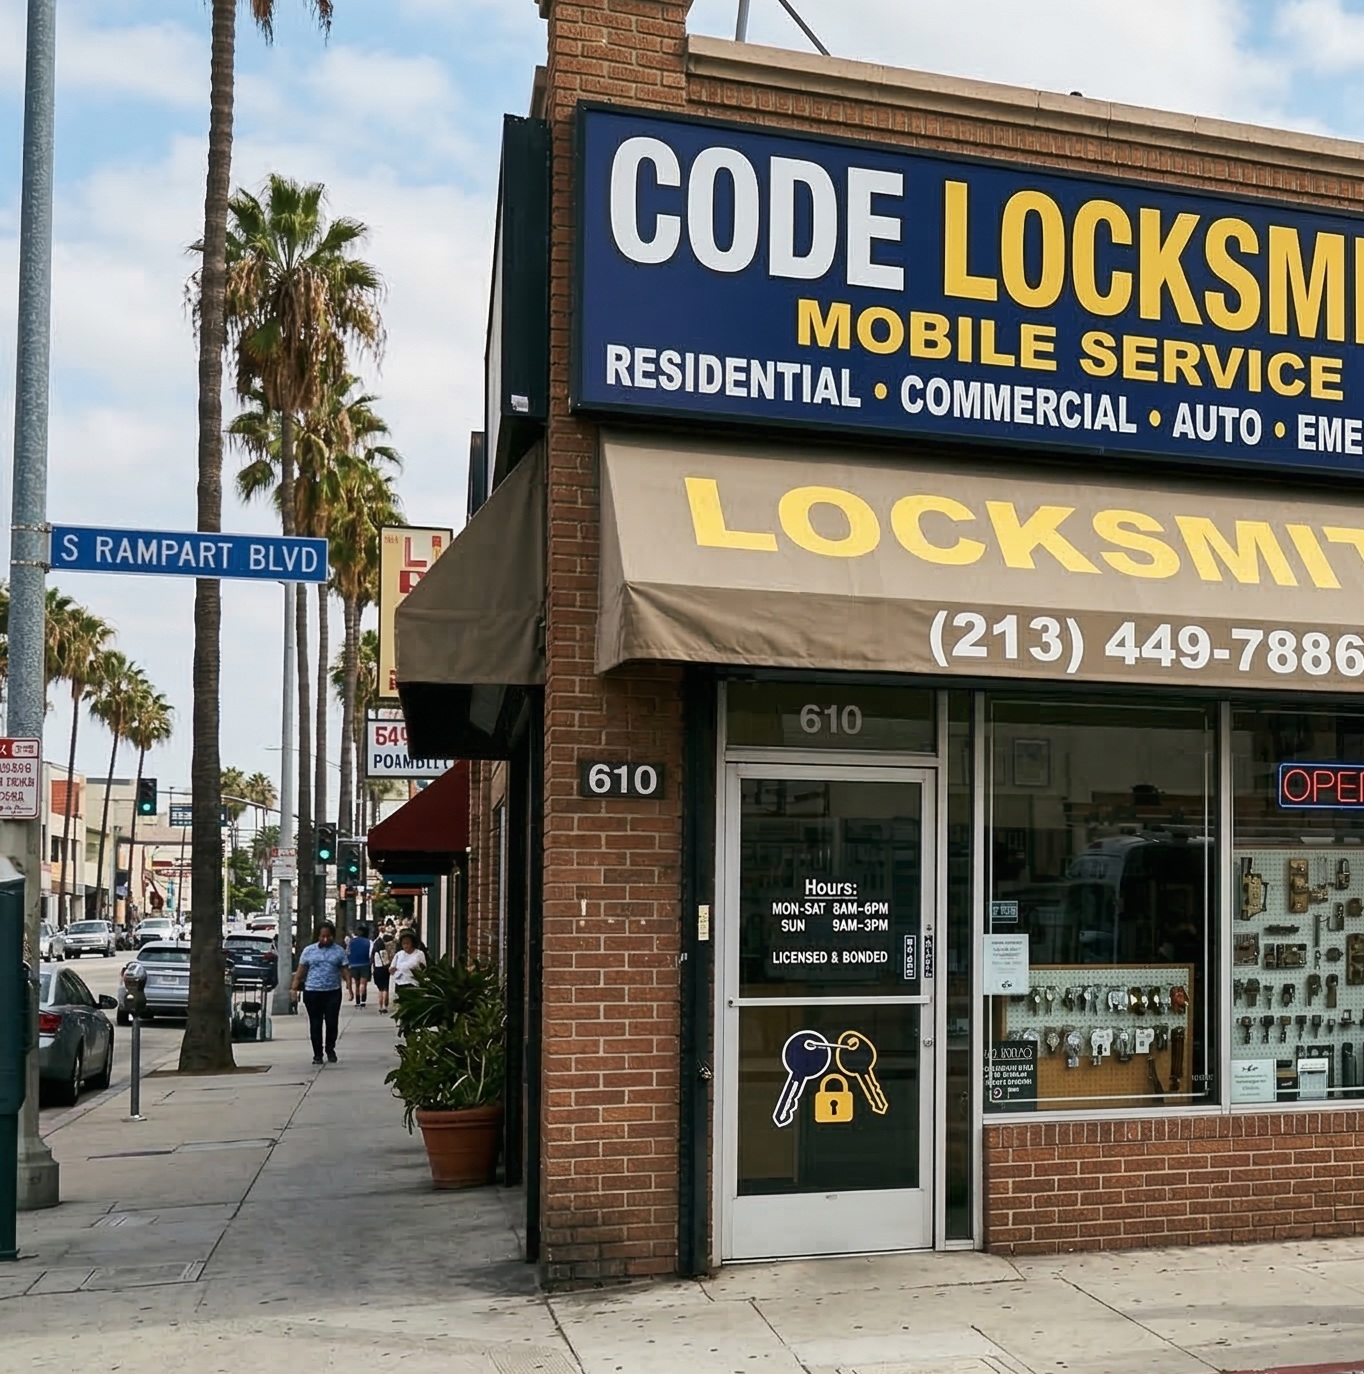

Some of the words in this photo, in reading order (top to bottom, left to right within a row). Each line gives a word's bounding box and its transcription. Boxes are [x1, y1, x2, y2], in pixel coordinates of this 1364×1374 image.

[611, 137, 904, 291] CODE
[798, 299, 1057, 370] MOBILE
[1080, 331, 1343, 400] SERVICE
[606, 344, 861, 408] RESIDENTIAL
[901, 375, 1137, 433] COMMERCIAL
[1172, 403, 1262, 445] AUTO
[61, 534, 78, 561] S
[96, 536, 233, 570] RAMPART
[249, 542, 318, 573] BLVD
[929, 610, 1084, 674] (213)
[800, 704, 862, 735] 610
[588, 763, 658, 795] 610
[805, 879, 858, 896] Hours:
[772, 902, 826, 915] MON-SAT
[832, 902, 889, 915] 8AM-6PM
[781, 919, 805, 932] SUN
[832, 919, 889, 931] 9AM-3PM
[772, 951, 828, 964] LICENSED
[831, 951, 839, 964] &
[842, 951, 888, 963] BONDED
